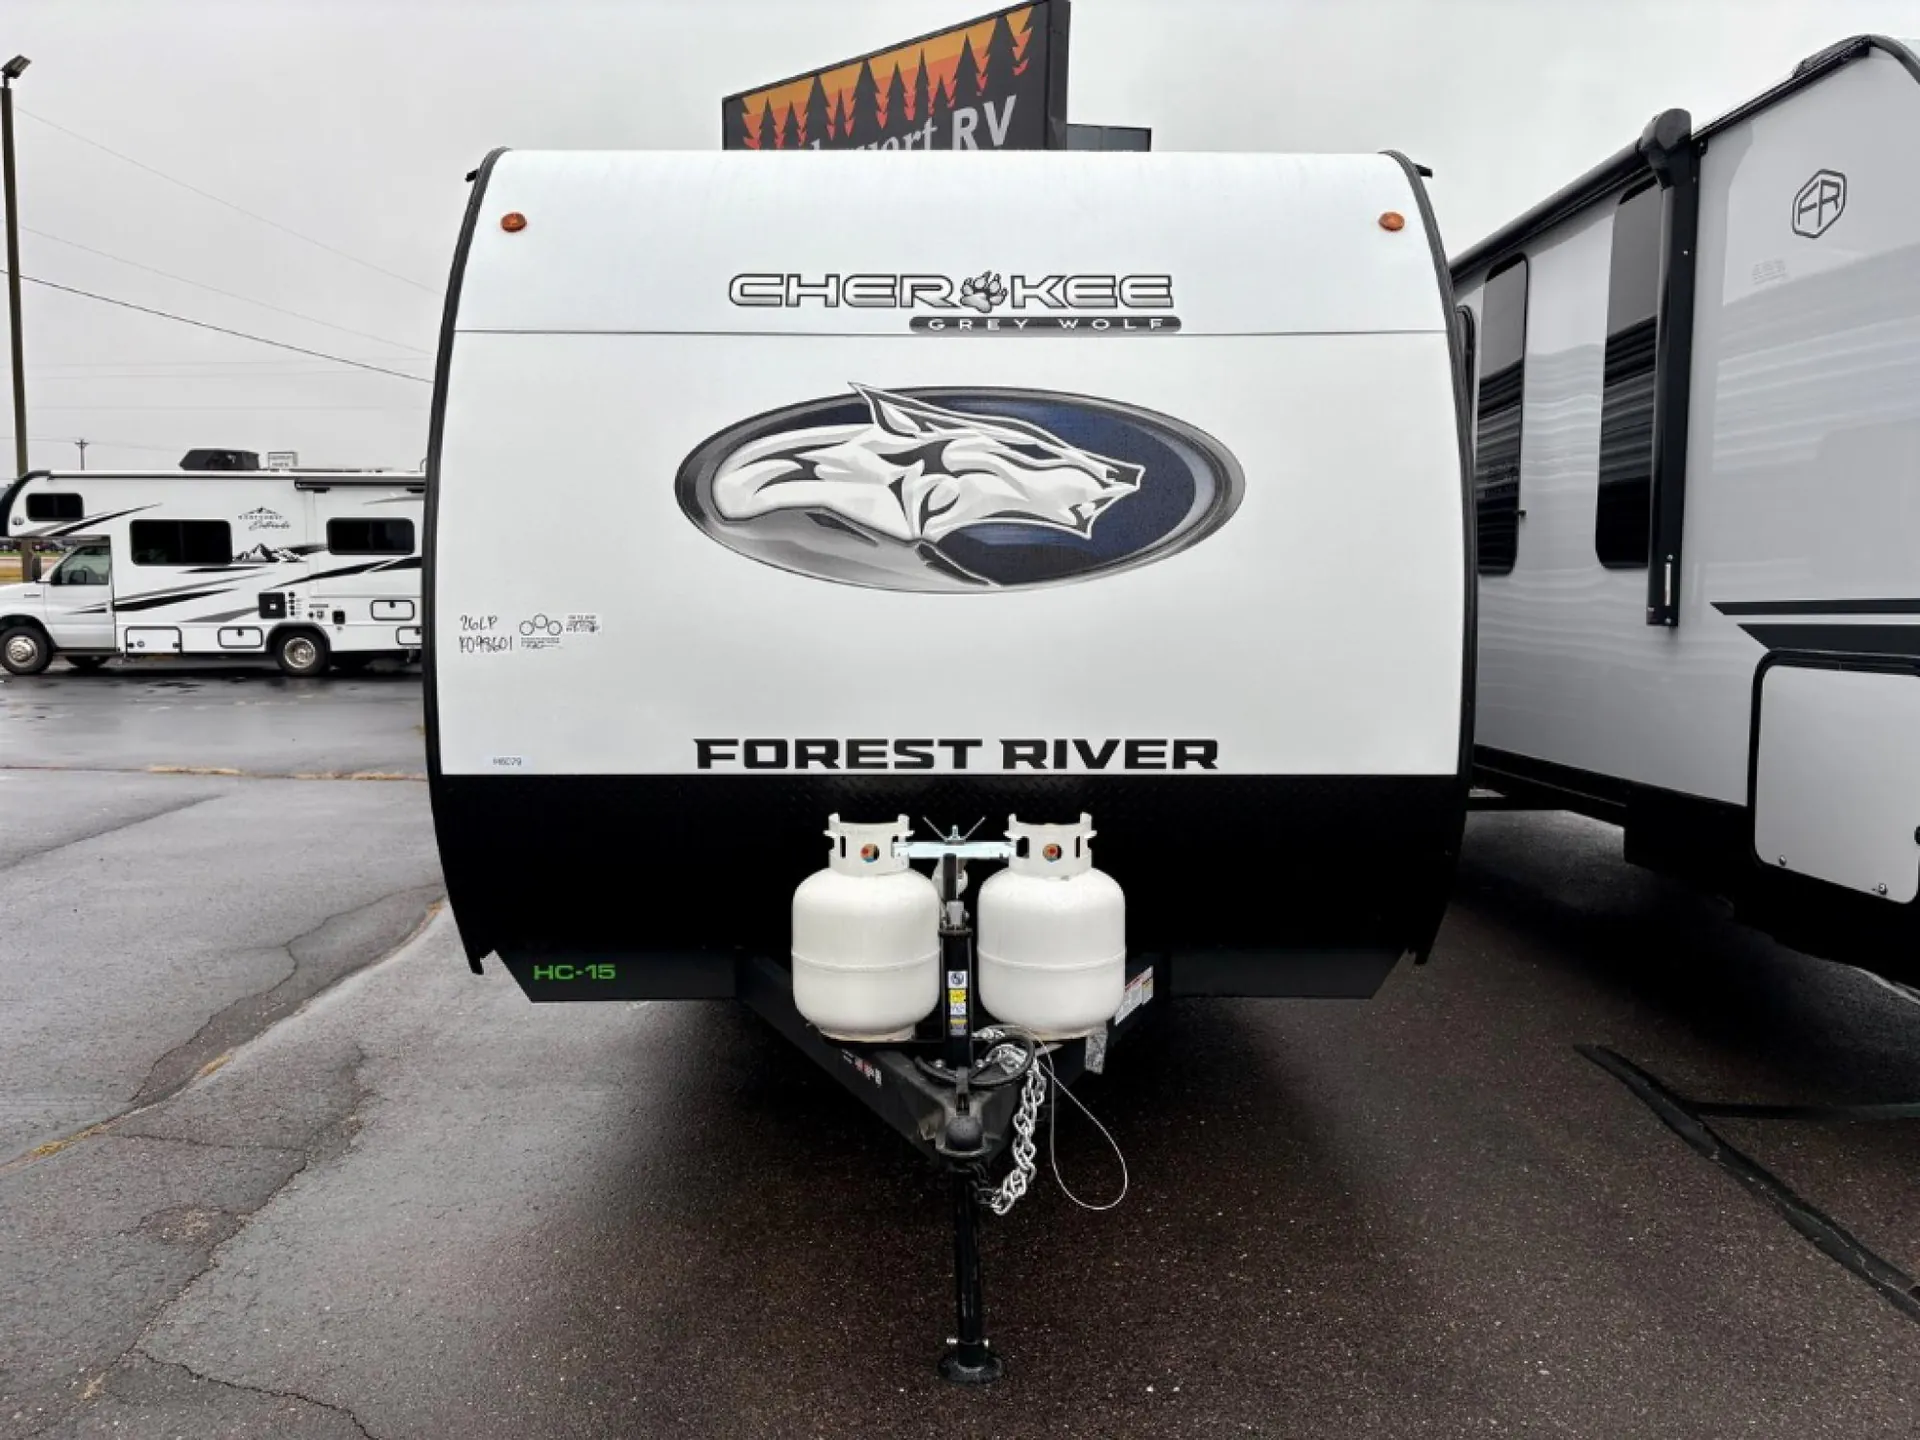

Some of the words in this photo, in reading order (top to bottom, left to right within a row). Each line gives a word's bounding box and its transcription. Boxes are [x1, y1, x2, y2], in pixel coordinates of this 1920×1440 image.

[953, 95, 1017, 150] RV
[729, 272, 1174, 313] CHERKEE
[927, 318, 1028, 331] GREY
[1058, 318, 1164, 331] WOLF
[694, 739, 982, 769] FOREST
[1000, 739, 1218, 769] RIVER
[533, 964, 616, 981] HC-15
